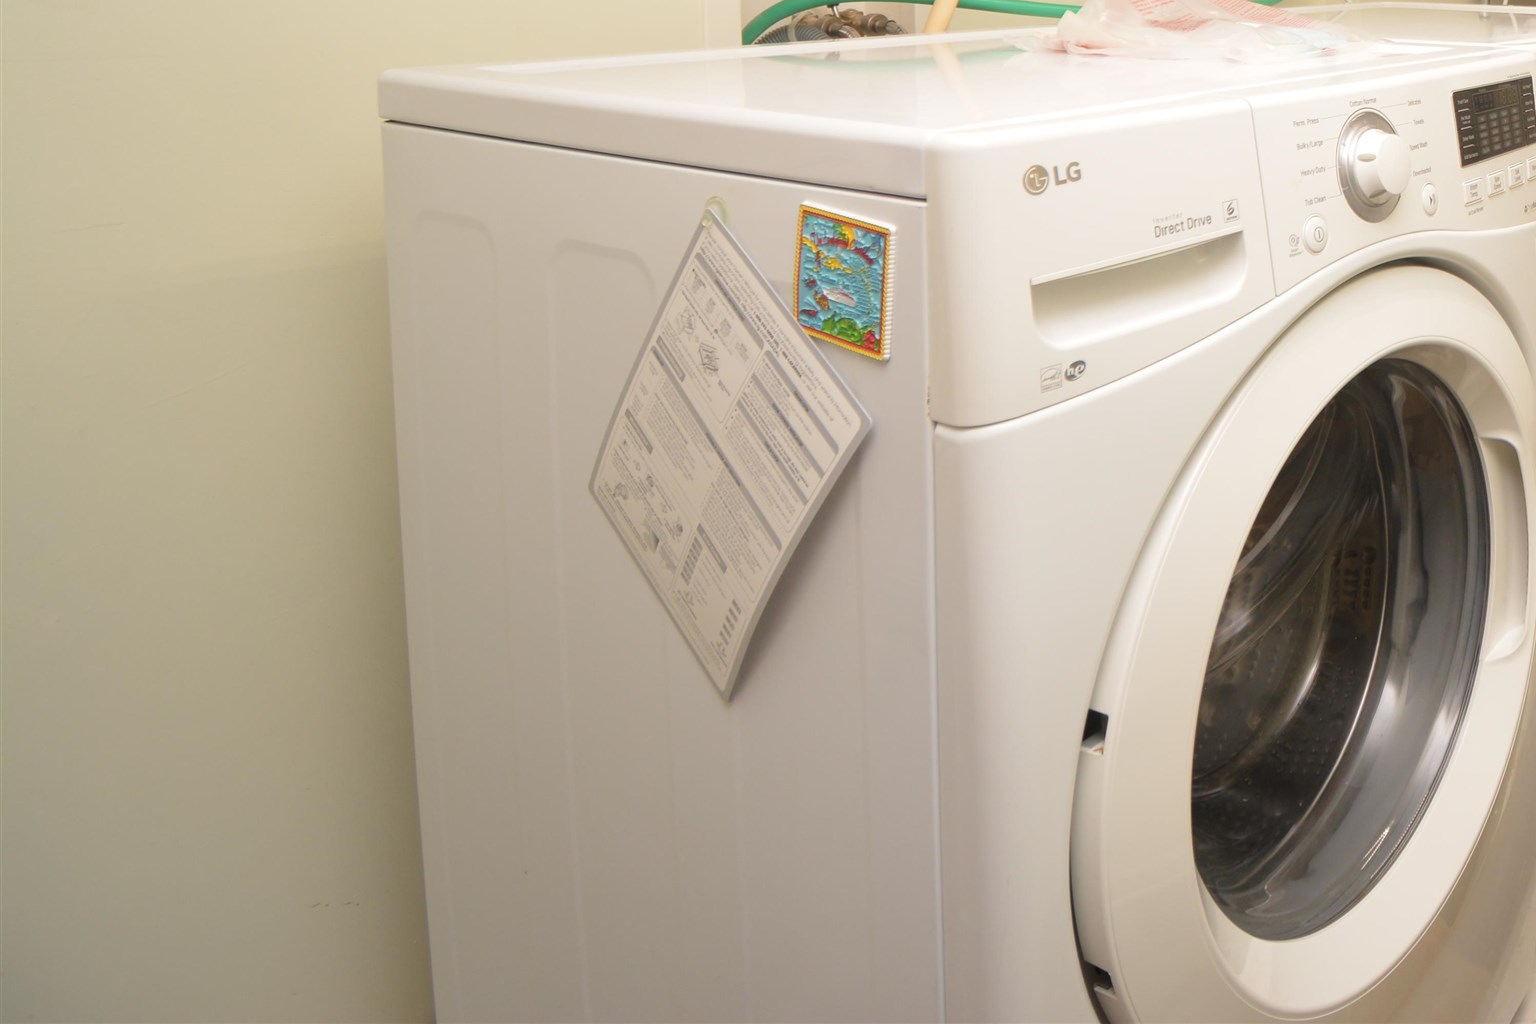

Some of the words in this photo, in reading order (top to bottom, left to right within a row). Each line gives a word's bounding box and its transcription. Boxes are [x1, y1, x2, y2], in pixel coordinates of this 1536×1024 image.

[1053, 161, 1082, 187] LG
[1154, 220, 1185, 239] Direct
[1186, 214, 1212, 231] Drive
